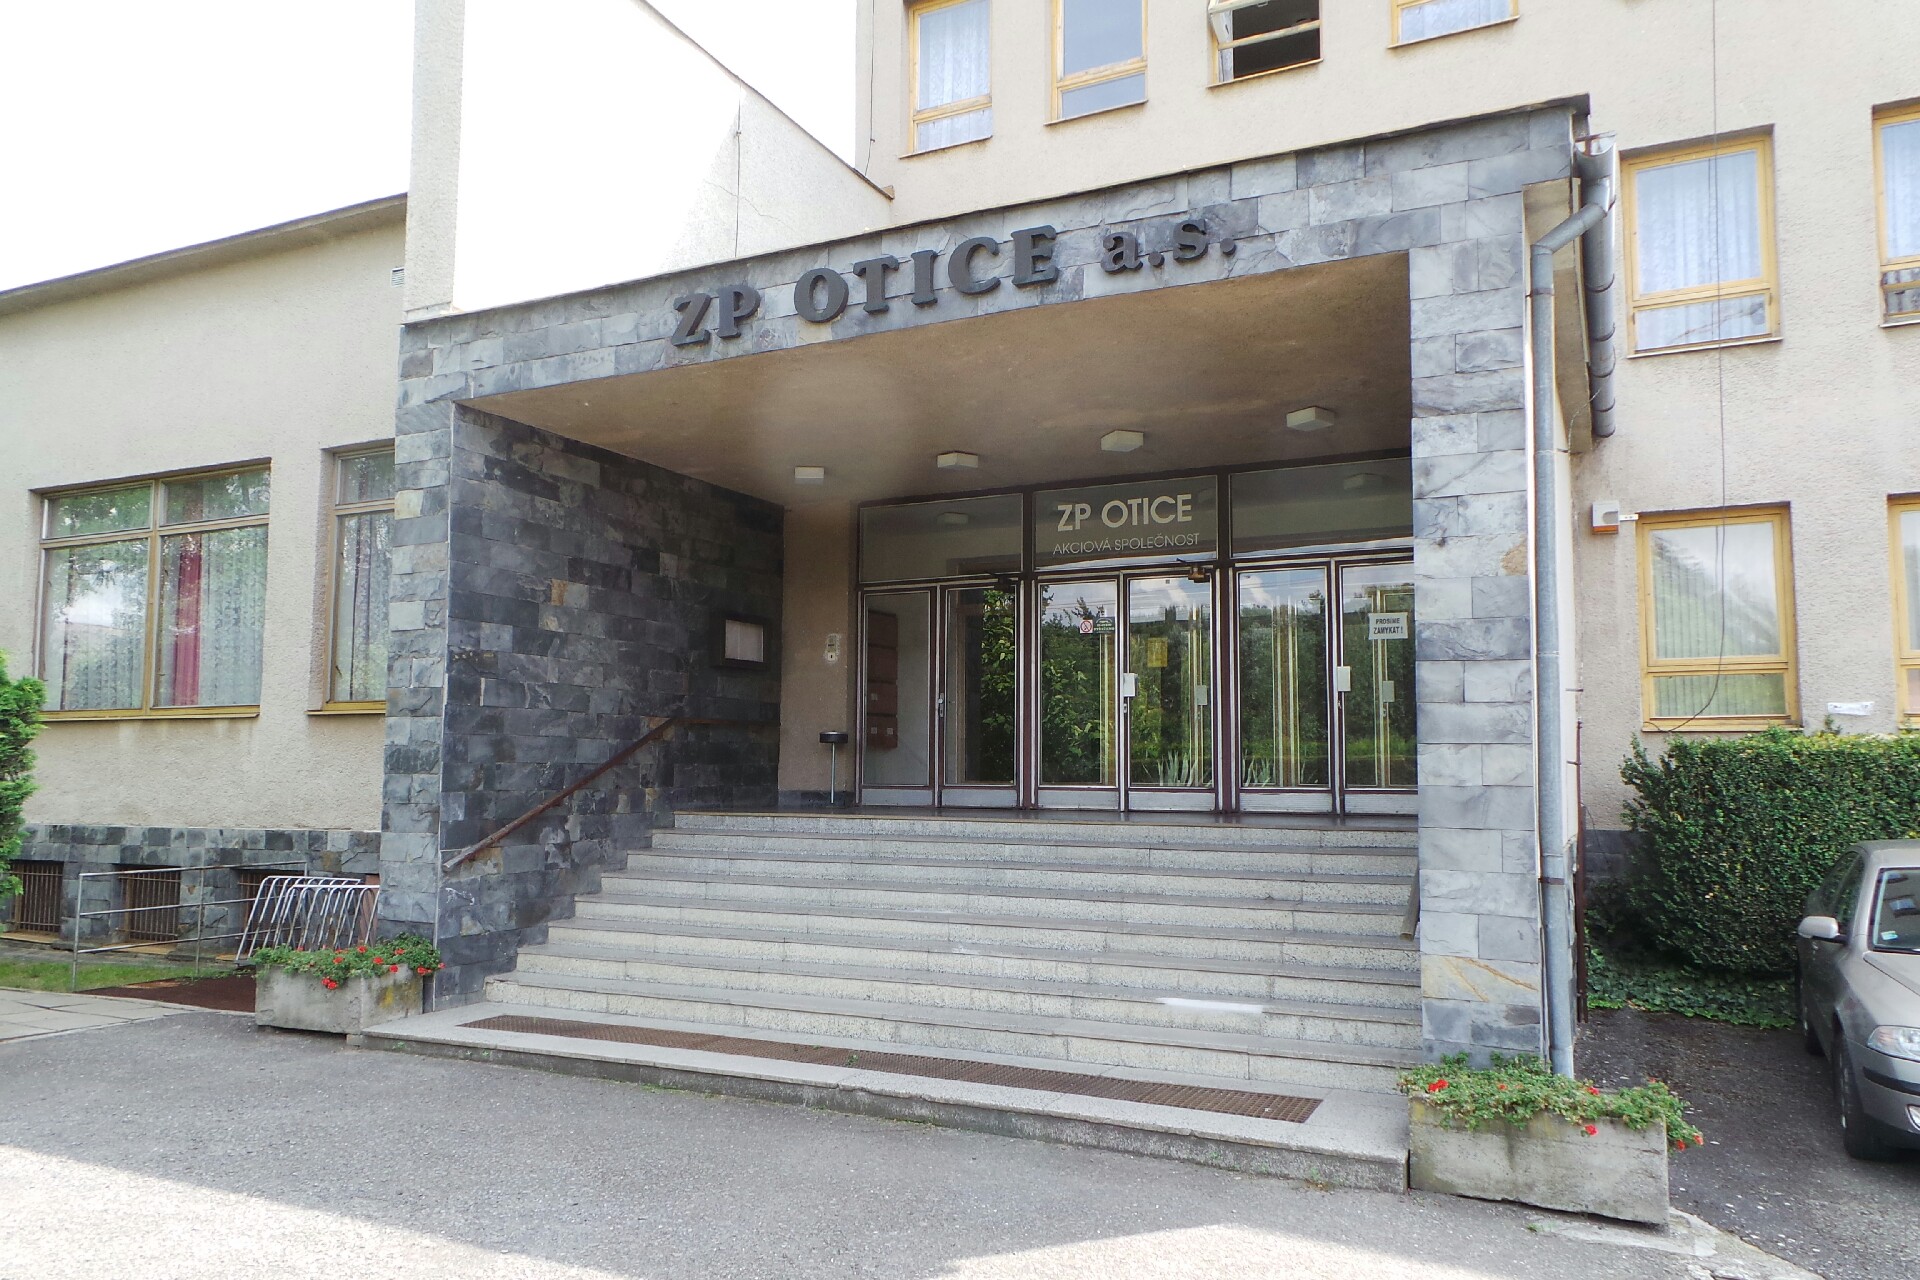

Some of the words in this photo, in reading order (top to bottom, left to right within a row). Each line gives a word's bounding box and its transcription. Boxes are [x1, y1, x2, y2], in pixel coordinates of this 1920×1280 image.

[674, 286, 760, 346] ZP
[794, 225, 1059, 322] OTICE
[1103, 219, 1237, 274] a.s.
[1057, 503, 1091, 532] ZP
[1101, 494, 1192, 528] OTICE
[1053, 537, 1112, 555] AKCIOVÁ
[1114, 533, 1200, 550] SPOLEČNOST
